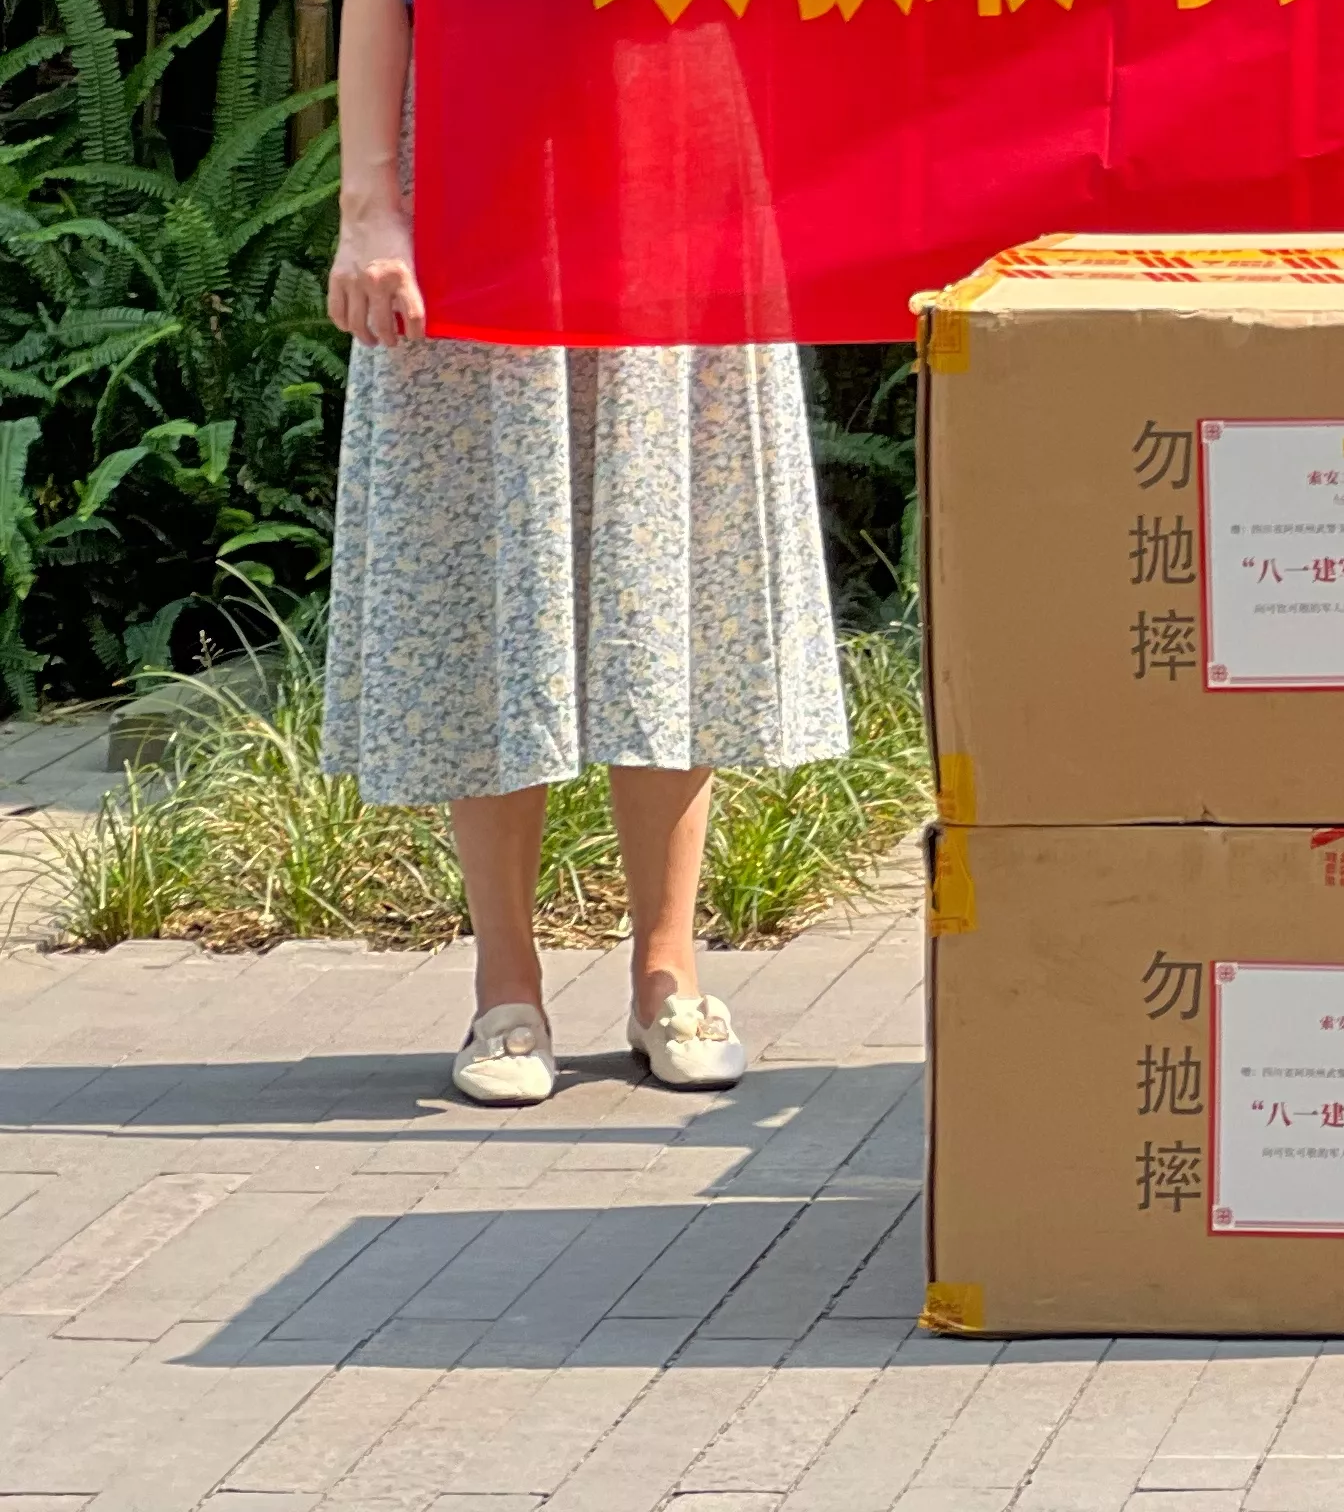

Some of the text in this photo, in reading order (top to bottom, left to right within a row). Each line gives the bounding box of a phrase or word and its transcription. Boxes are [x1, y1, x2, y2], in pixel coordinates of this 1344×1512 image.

[1129, 420, 1197, 681] 勿抛摔
[1136, 950, 1203, 1213] 勿抛摔
